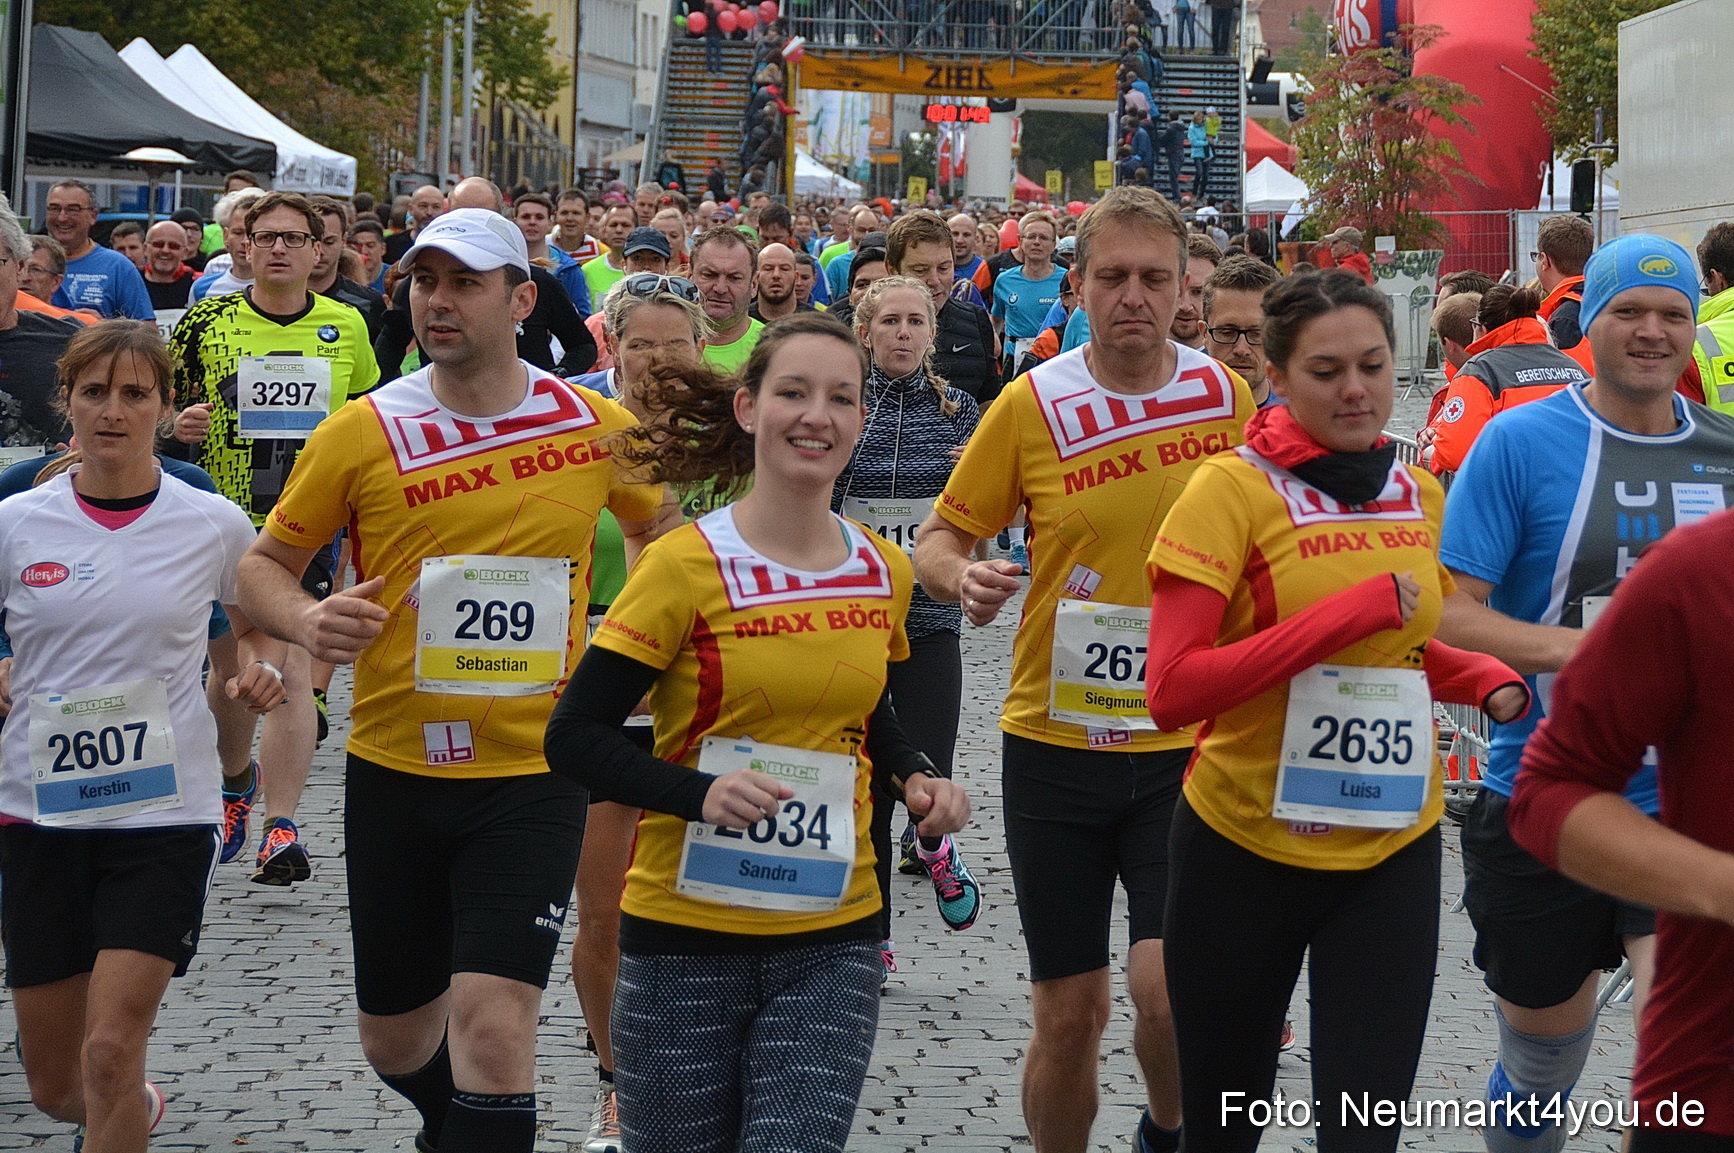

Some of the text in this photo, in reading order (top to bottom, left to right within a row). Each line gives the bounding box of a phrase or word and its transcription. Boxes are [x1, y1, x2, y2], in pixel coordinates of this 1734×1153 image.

[924, 64, 995, 91] ZIEL
[1515, 368, 1584, 383] BEREITSCHAFTEN
[251, 381, 318, 407] 3297
[1062, 449, 1148, 496] MAX
[402, 463, 501, 509] MAX
[877, 506, 912, 514] BOCK
[1297, 531, 1375, 560] MAX
[25, 567, 65, 582] Hervis
[479, 568, 530, 582] BOCK
[454, 598, 535, 642] 269
[734, 603, 892, 640] MAX BÖGL
[425, 633, 432, 641] D
[456, 655, 528, 672] Sebastian
[1354, 682, 1398, 698] BOCK
[75, 695, 126, 713] BOCK
[48, 720, 149, 774] 2607
[1308, 714, 1413, 765] 2635
[37, 770, 44, 778] D
[767, 760, 820, 781] BOCK
[79, 779, 132, 800] Kerstin
[1340, 779, 1381, 799] Luisa
[696, 827, 703, 836] D
[738, 858, 798, 883] Sandra
